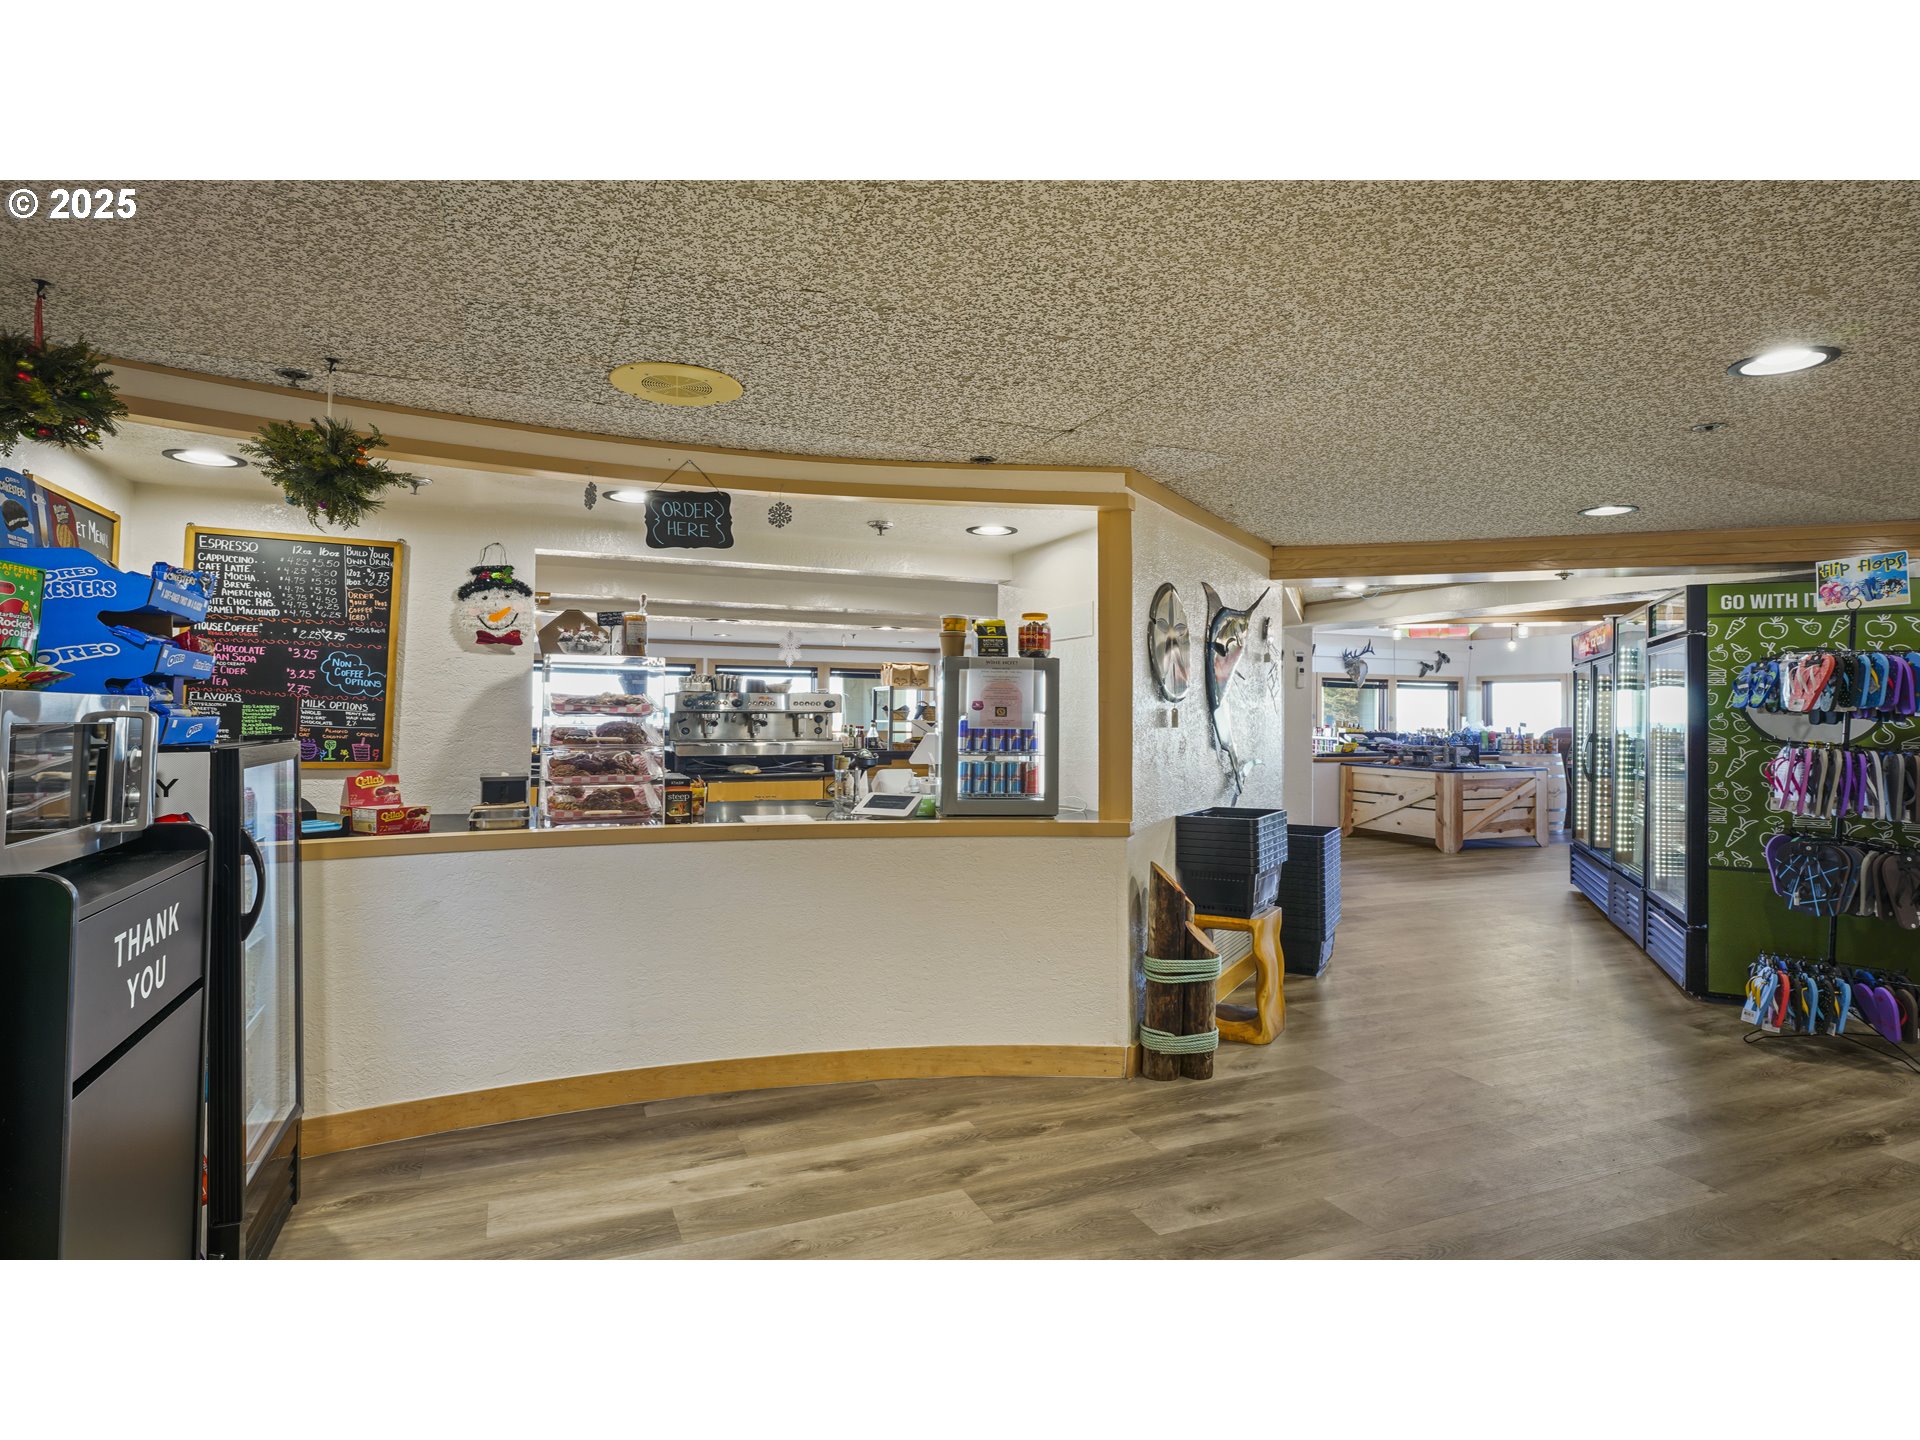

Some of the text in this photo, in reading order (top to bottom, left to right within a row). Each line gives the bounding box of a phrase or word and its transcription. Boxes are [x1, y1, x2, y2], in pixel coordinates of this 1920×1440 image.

[662, 501, 716, 518] ORDER
[667, 520, 711, 538] HERE
[198, 535, 258, 552] ESPRESSO
[198, 553, 254, 564] CAPPUCCINO
[346, 546, 390, 561] BUILD YOUR
[225, 564, 251, 572] LATTE
[1820, 554, 1904, 578] flip flops
[224, 572, 256, 581] MOCHA
[44, 580, 116, 599] KESTERS
[223, 580, 251, 589] BREVE
[221, 588, 272, 598] AMERICANO
[348, 591, 374, 599] ORDER
[1720, 594, 1744, 609] GO
[1750, 593, 1797, 609] WITH
[237, 607, 280, 616] MACCHIATO
[224, 622, 259, 633] COFFEE
[215, 642, 266, 655] CHOCOLATE
[36, 643, 120, 667] OREO
[167, 654, 186, 667] OREO
[232, 653, 257, 663] SODA
[220, 666, 248, 675] CIDER
[334, 667, 364, 678] COFFEE
[212, 675, 228, 686] TEA
[345, 678, 382, 688] OPTIONS
[189, 692, 242, 703] FLAVORS
[302, 699, 368, 711] MILK OPTIONS
[356, 775, 385, 789] Cella's
[667, 794, 690, 802] steep
[381, 810, 405, 822] Cella's
[114, 902, 179, 968] THANK
[127, 955, 166, 1008] YOU
